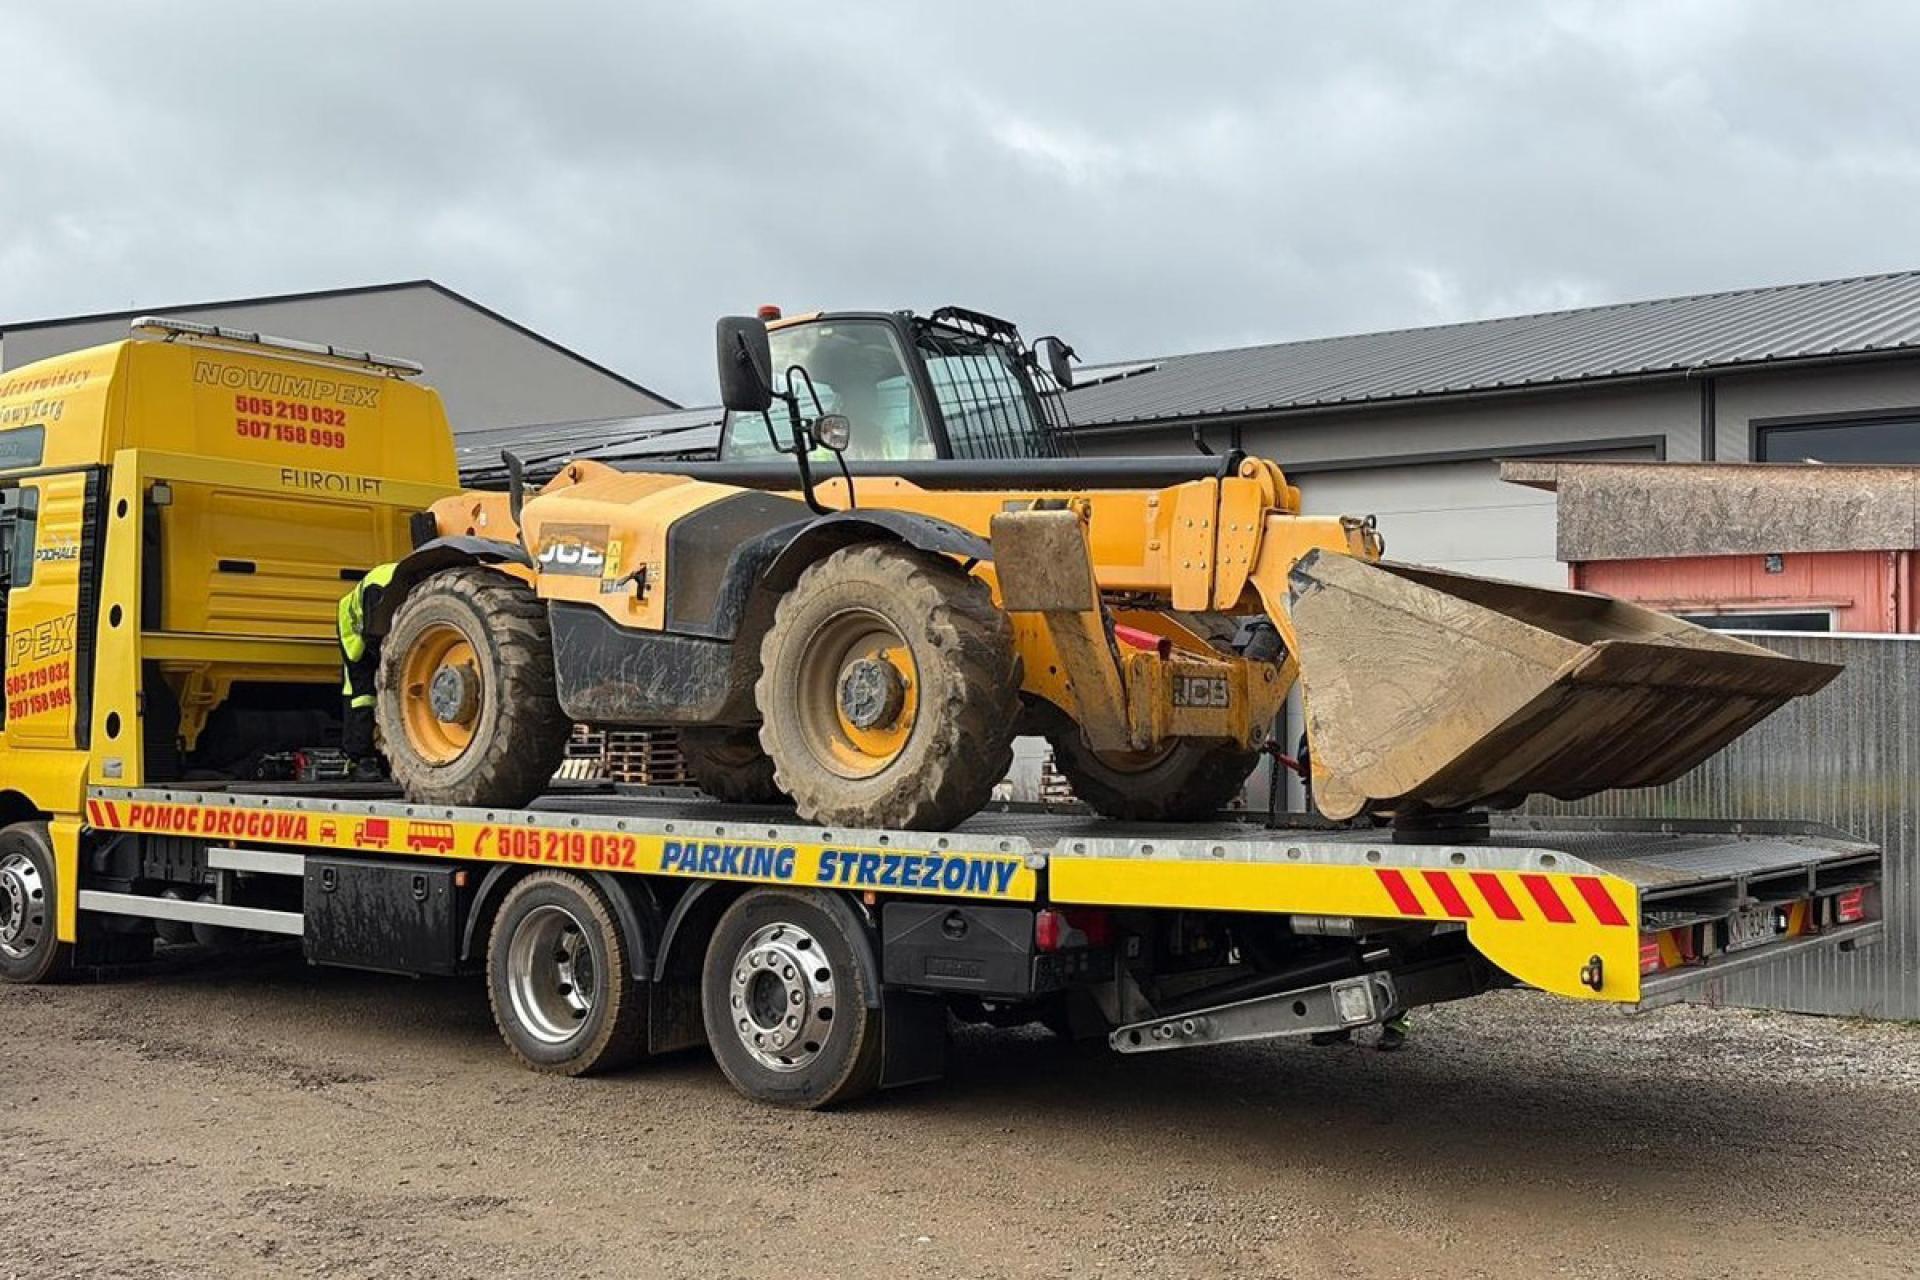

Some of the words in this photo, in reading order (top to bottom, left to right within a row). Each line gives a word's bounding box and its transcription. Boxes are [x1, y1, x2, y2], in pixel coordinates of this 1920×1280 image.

[193, 361, 380, 408] NOVIMPEX
[236, 396, 272, 416] 505
[274, 402, 308, 421] 219
[311, 407, 346, 427] 032
[6, 613, 76, 668] PEX
[129, 804, 198, 832] POMOC
[202, 812, 308, 840] DROGOWA
[498, 829, 541, 859] 505
[545, 832, 585, 864] 219
[590, 836, 636, 868] 032
[660, 840, 796, 879] PARKING
[816, 850, 1016, 893] STRZEŻONY
